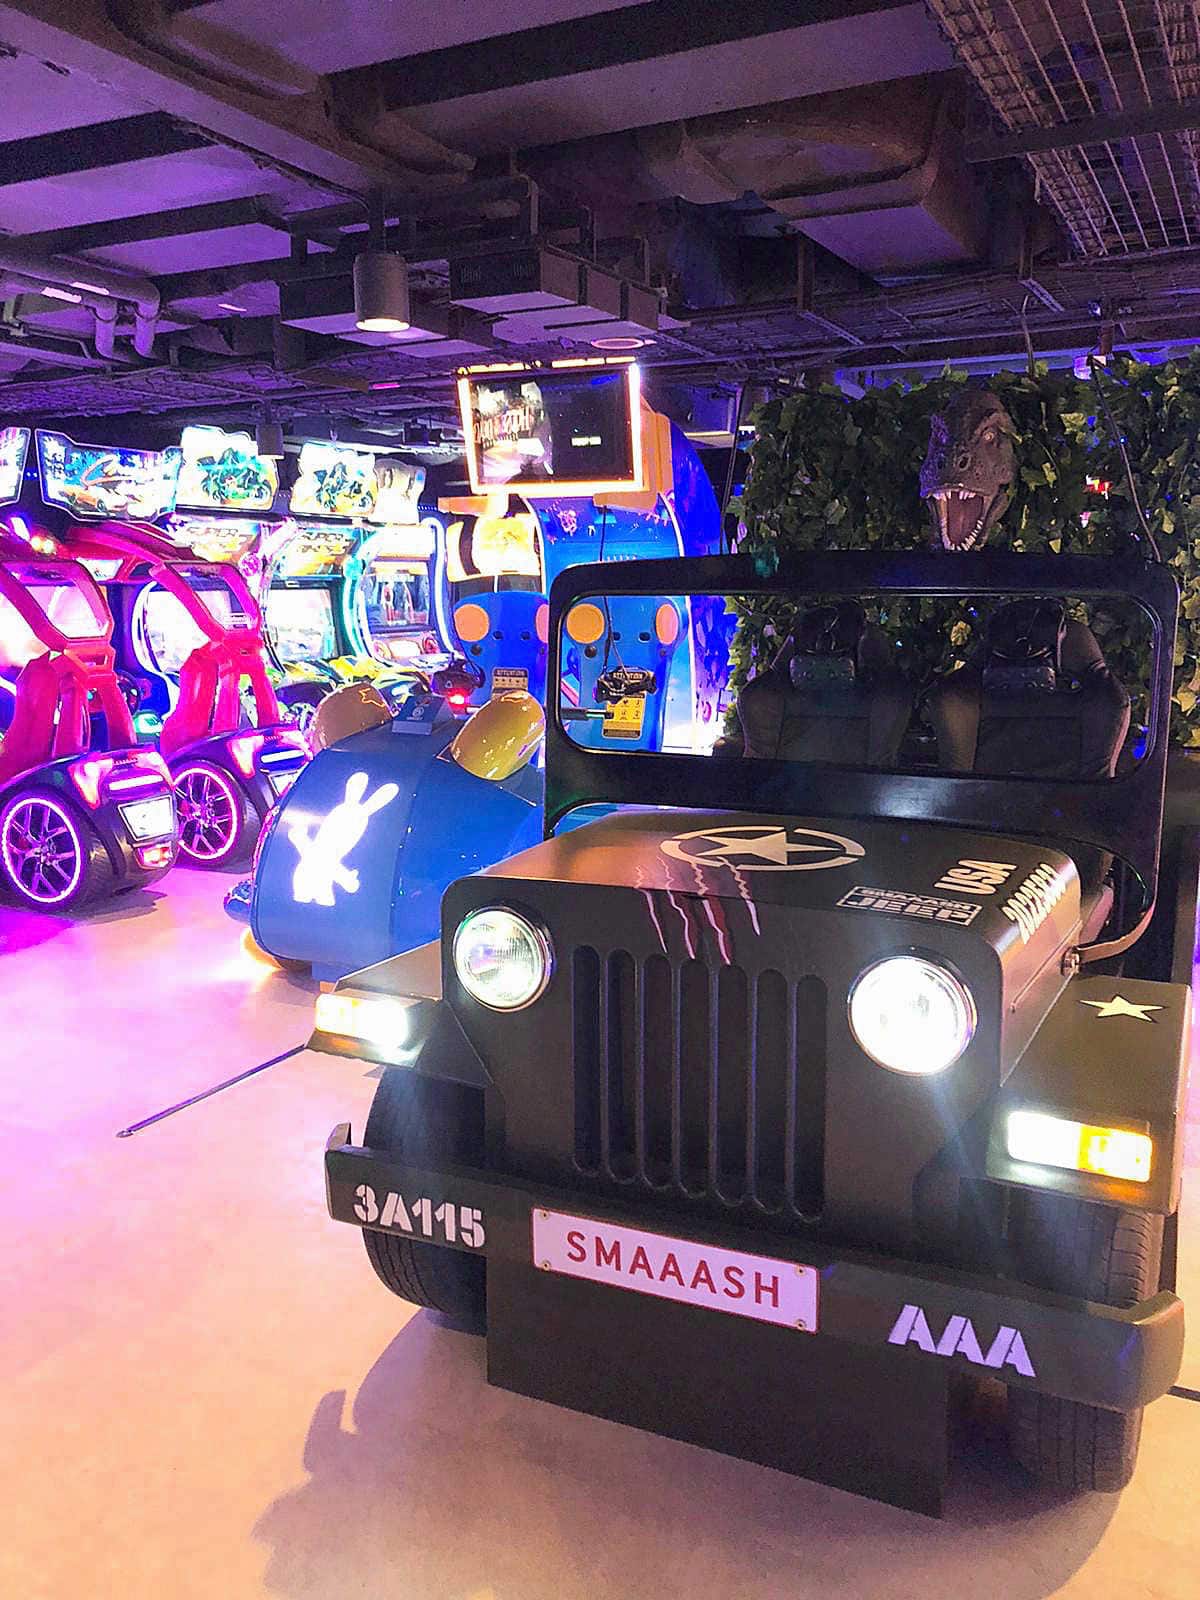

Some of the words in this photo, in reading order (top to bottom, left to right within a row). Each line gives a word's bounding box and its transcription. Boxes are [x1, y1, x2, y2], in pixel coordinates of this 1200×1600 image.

[846, 897, 969, 919] JEEP
[934, 859, 1017, 895] USA
[354, 1184, 485, 1247] 3A115
[566, 1231, 779, 1308] SMAAASH
[888, 1304, 1036, 1377] AAA
